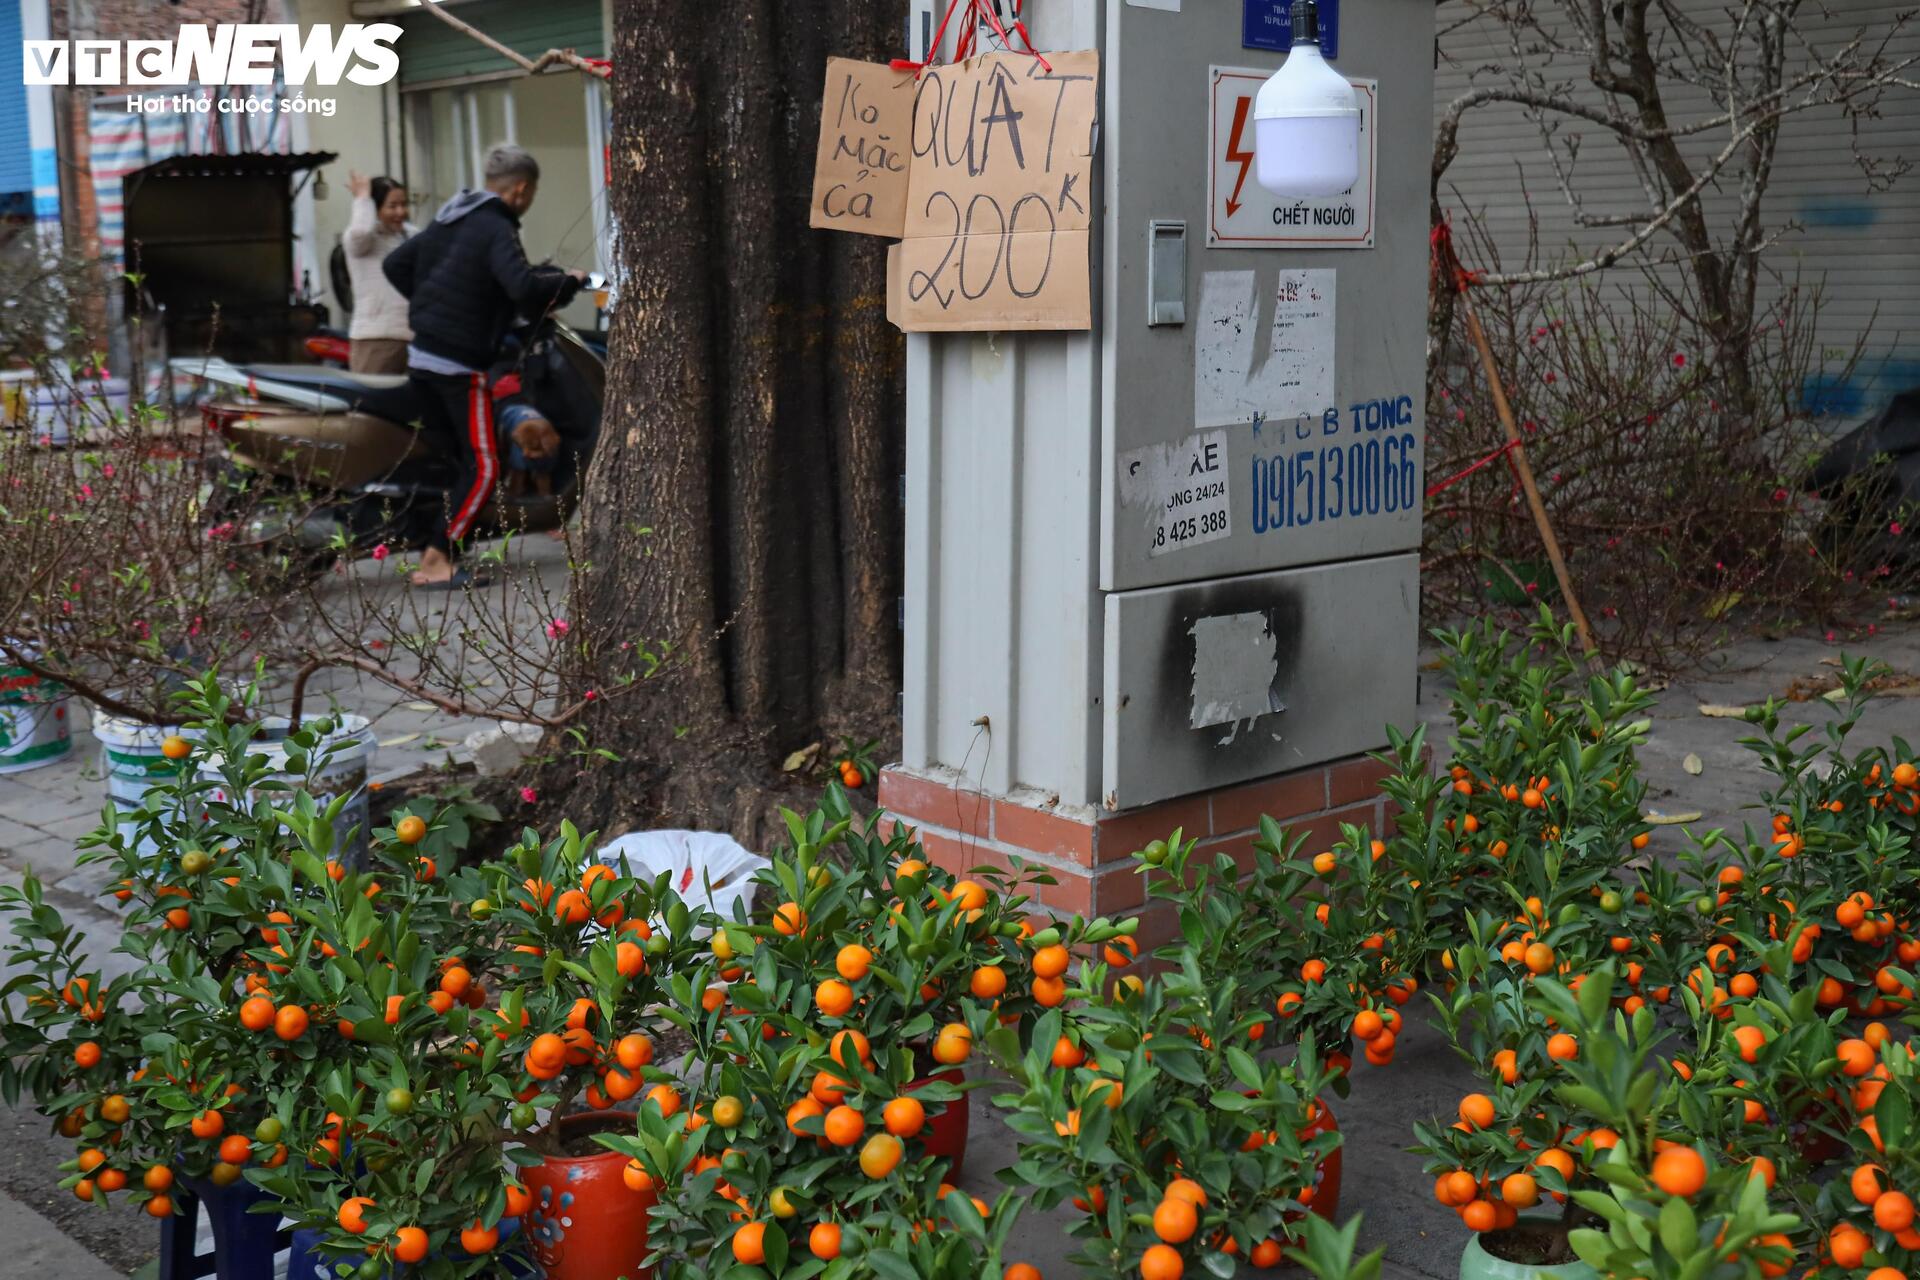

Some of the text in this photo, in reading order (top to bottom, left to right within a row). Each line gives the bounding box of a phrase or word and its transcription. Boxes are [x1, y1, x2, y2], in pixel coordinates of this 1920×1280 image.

[837, 74, 880, 129] Ko
[822, 168, 874, 219] Cả
[1272, 201, 1355, 226] CHẾT NGƯỜI
[1195, 481, 1225, 503] 24/24
[1252, 433, 1415, 534] 0915130066
[1151, 509, 1227, 550] 8 425 388
